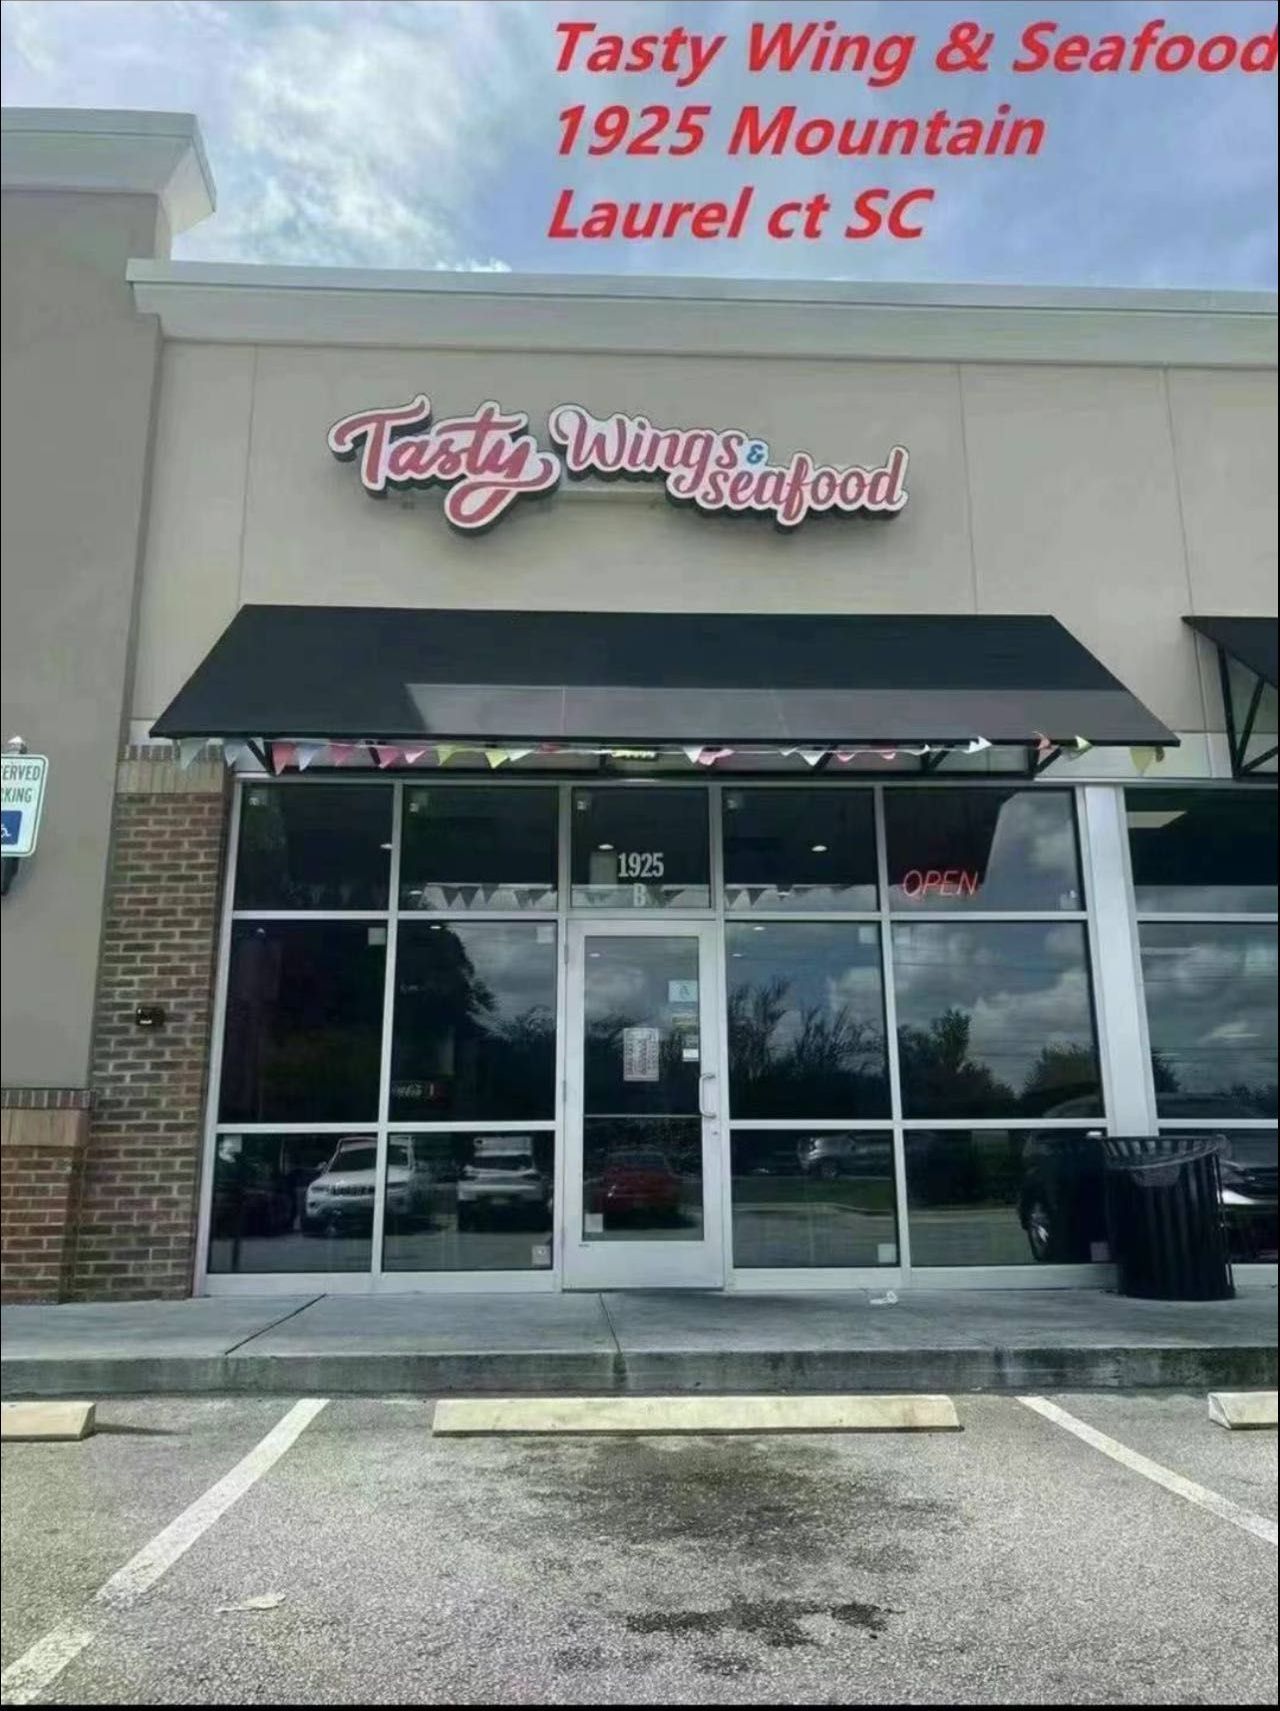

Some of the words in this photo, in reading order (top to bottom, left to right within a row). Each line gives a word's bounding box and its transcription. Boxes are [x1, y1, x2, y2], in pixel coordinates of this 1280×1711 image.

[332, 398, 555, 525] Tasty
[554, 408, 745, 495] Wings
[745, 443, 765, 466] &
[701, 448, 906, 522] seafood
[2, 764, 41, 781] ERVED
[618, 852, 664, 878] 1925
[633, 882, 648, 908] B
[902, 869, 978, 897] OPEN
